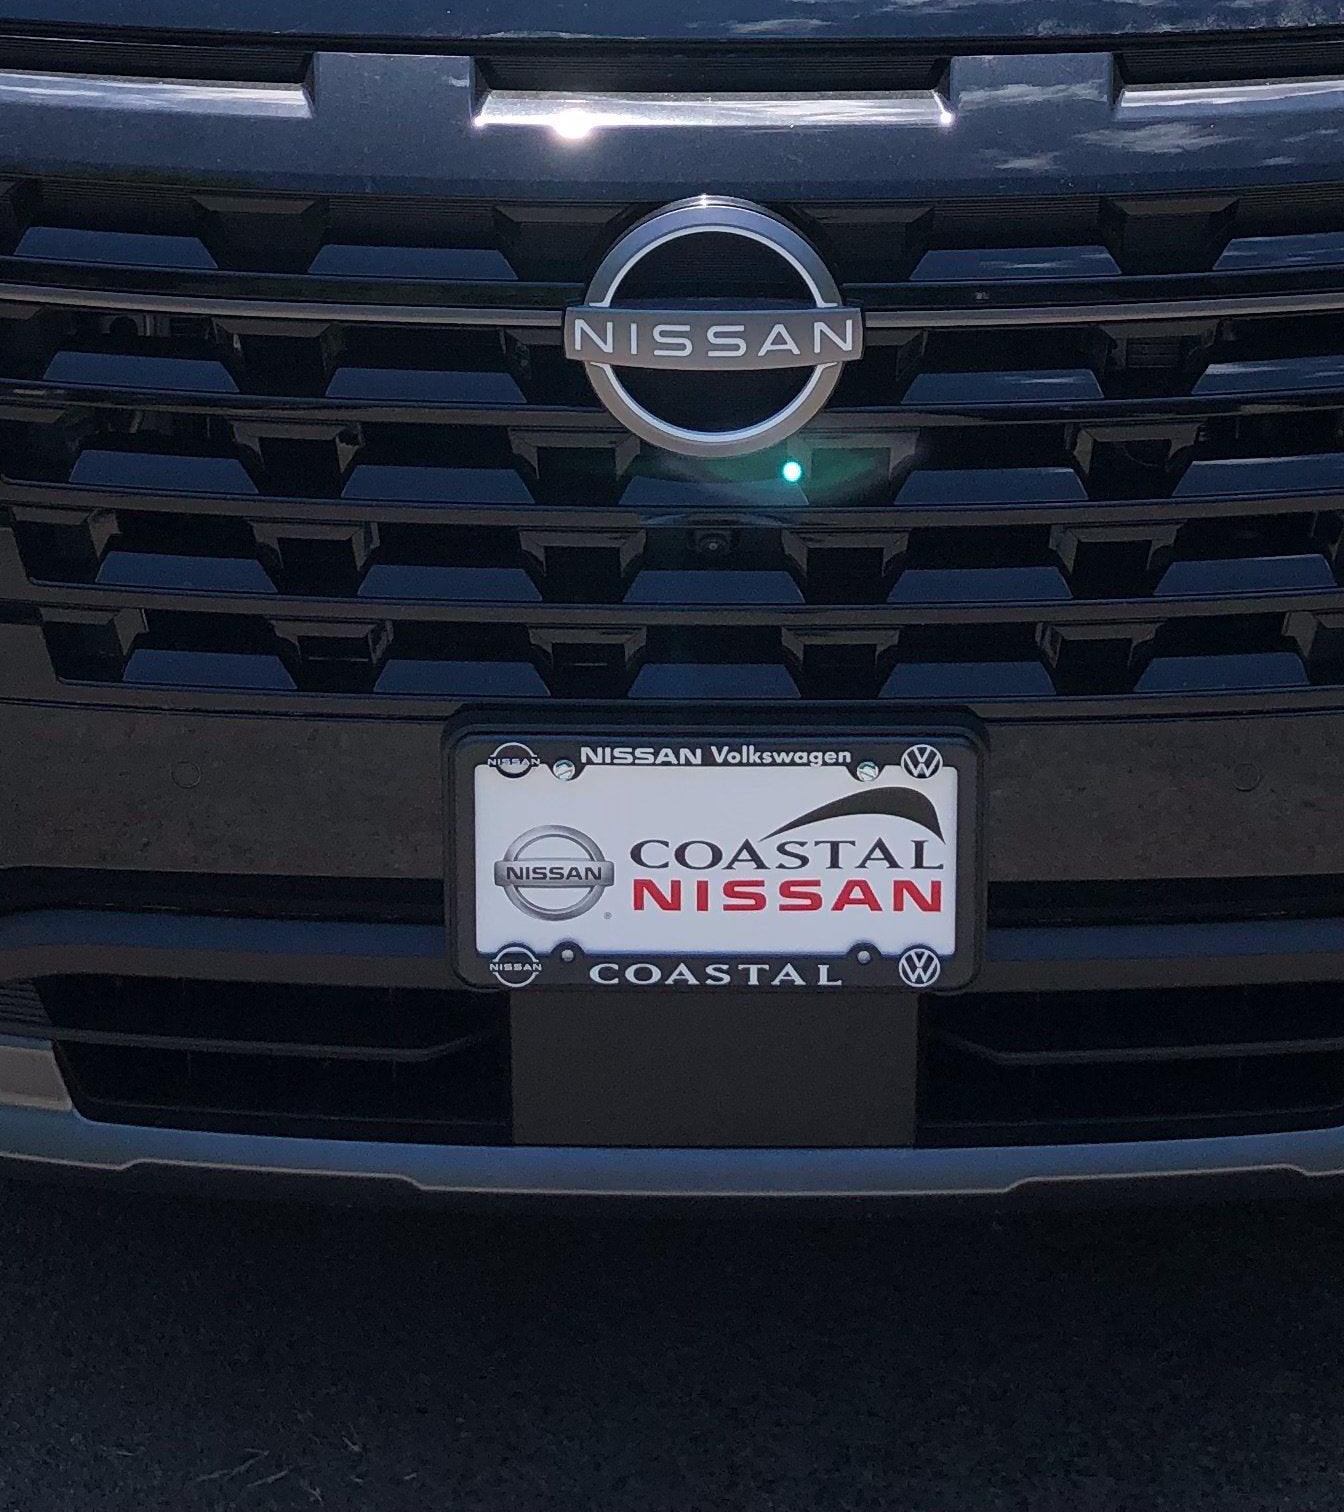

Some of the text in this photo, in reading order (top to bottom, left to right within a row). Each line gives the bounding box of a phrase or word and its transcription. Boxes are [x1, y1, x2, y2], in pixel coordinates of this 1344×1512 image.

[574, 318, 854, 357] NISSAN
[580, 745, 852, 768] NISSAN Volkswagen
[629, 837, 945, 870] COASTAL
[506, 866, 602, 881] NISSAN
[633, 879, 942, 913] NISSAN
[589, 962, 842, 987] COASTAL
